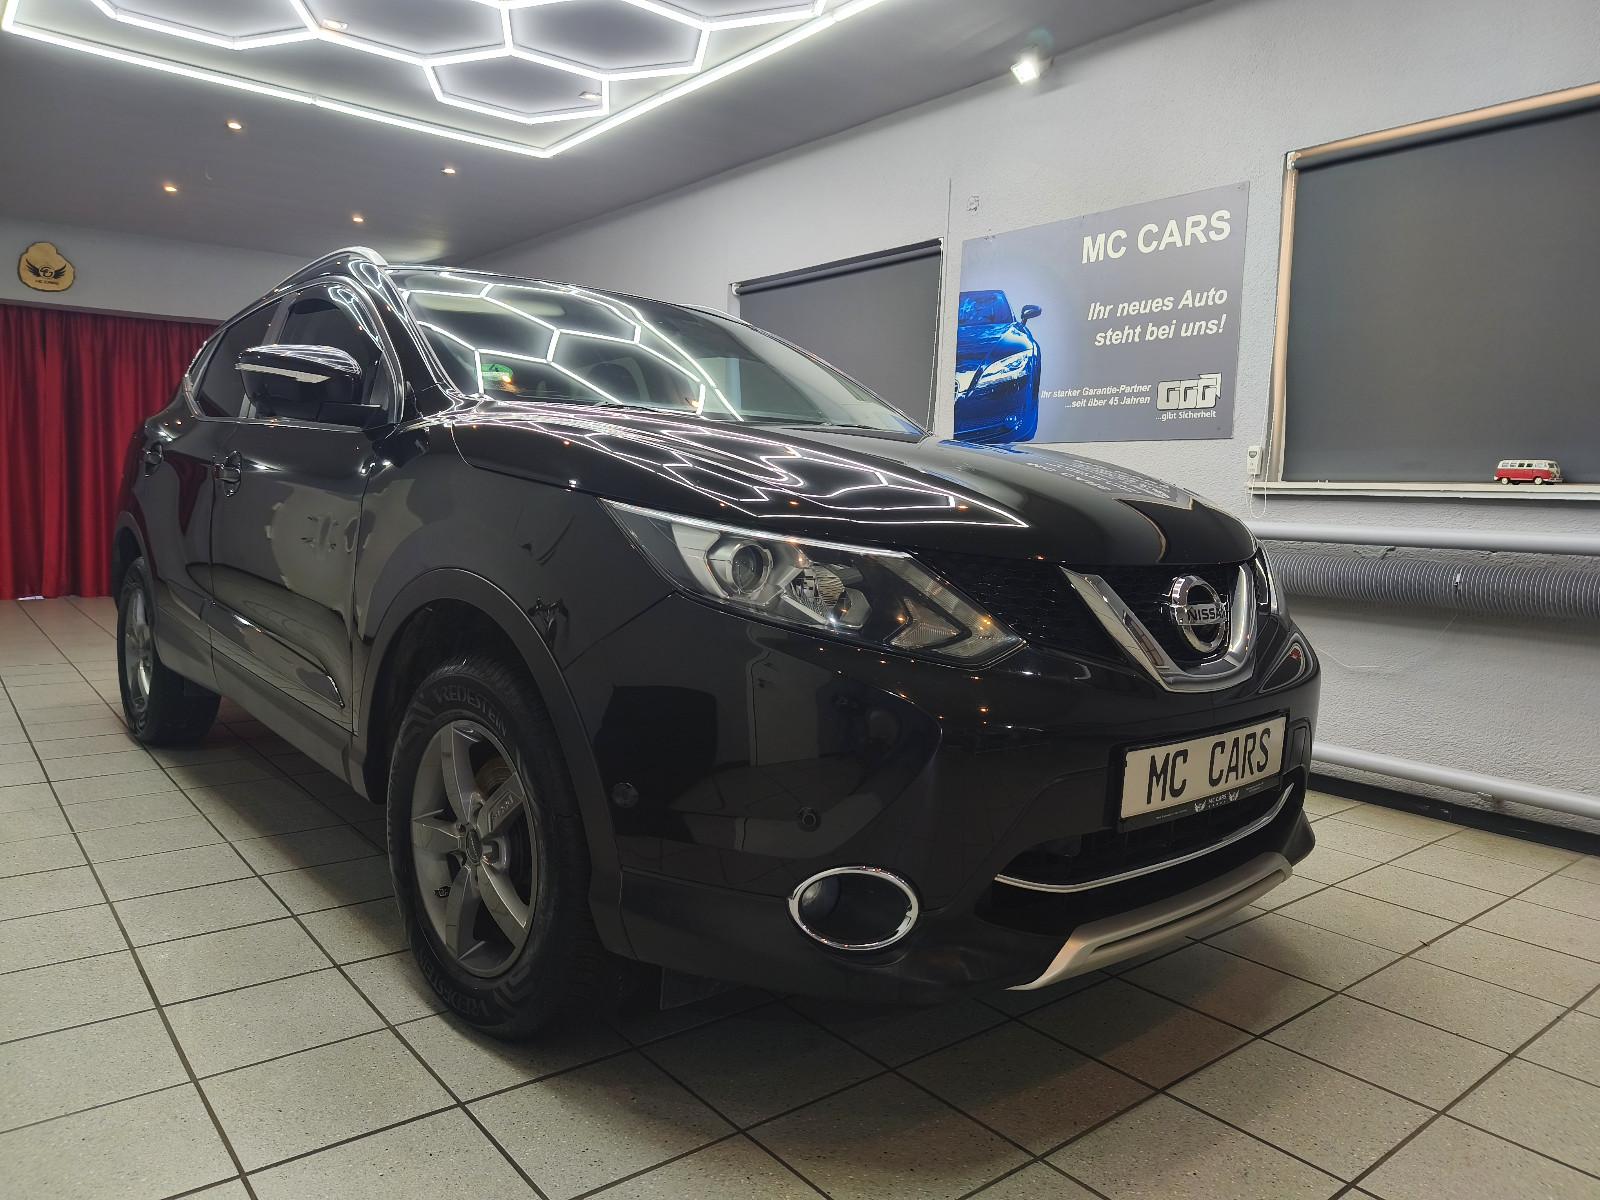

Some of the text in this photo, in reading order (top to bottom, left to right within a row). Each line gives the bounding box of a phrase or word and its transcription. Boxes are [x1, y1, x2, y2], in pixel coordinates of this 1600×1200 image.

[1081, 209, 1231, 264] MC CARS
[1087, 287, 1228, 321] Ihr neues Auto
[1094, 313, 1227, 347] steht bei uns!
[1040, 384, 1151, 399] Ihr starker Garantie-Partner
[1088, 398, 1107, 407] über
[1108, 396, 1119, 406] 45
[1120, 395, 1151, 405] Jahren
[1178, 410, 1217, 419] Sicherheit
[1147, 727, 1271, 805] MC CARS
